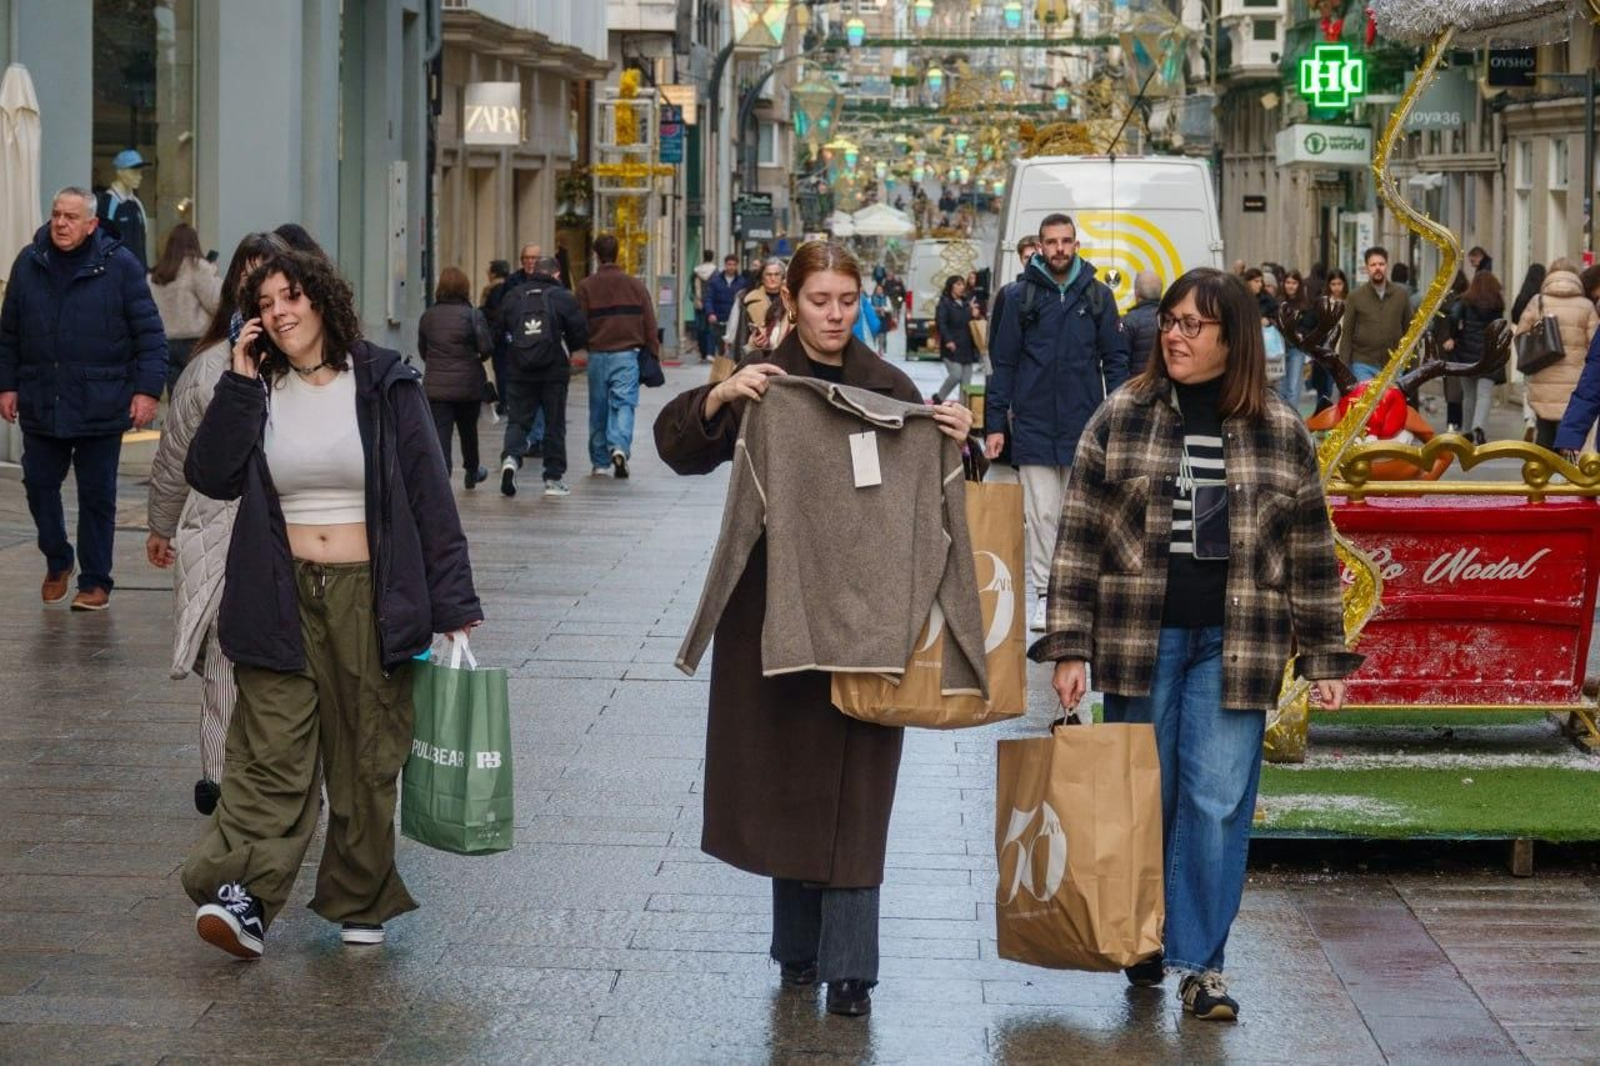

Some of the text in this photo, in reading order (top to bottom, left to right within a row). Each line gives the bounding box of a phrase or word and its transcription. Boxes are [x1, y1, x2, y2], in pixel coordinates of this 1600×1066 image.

[1490, 57, 1535, 68] OYSHO
[465, 106, 519, 132] ZARA
[1408, 111, 1461, 126] joya36
[1329, 138, 1365, 151] world
[1422, 547, 1552, 584] Nadal
